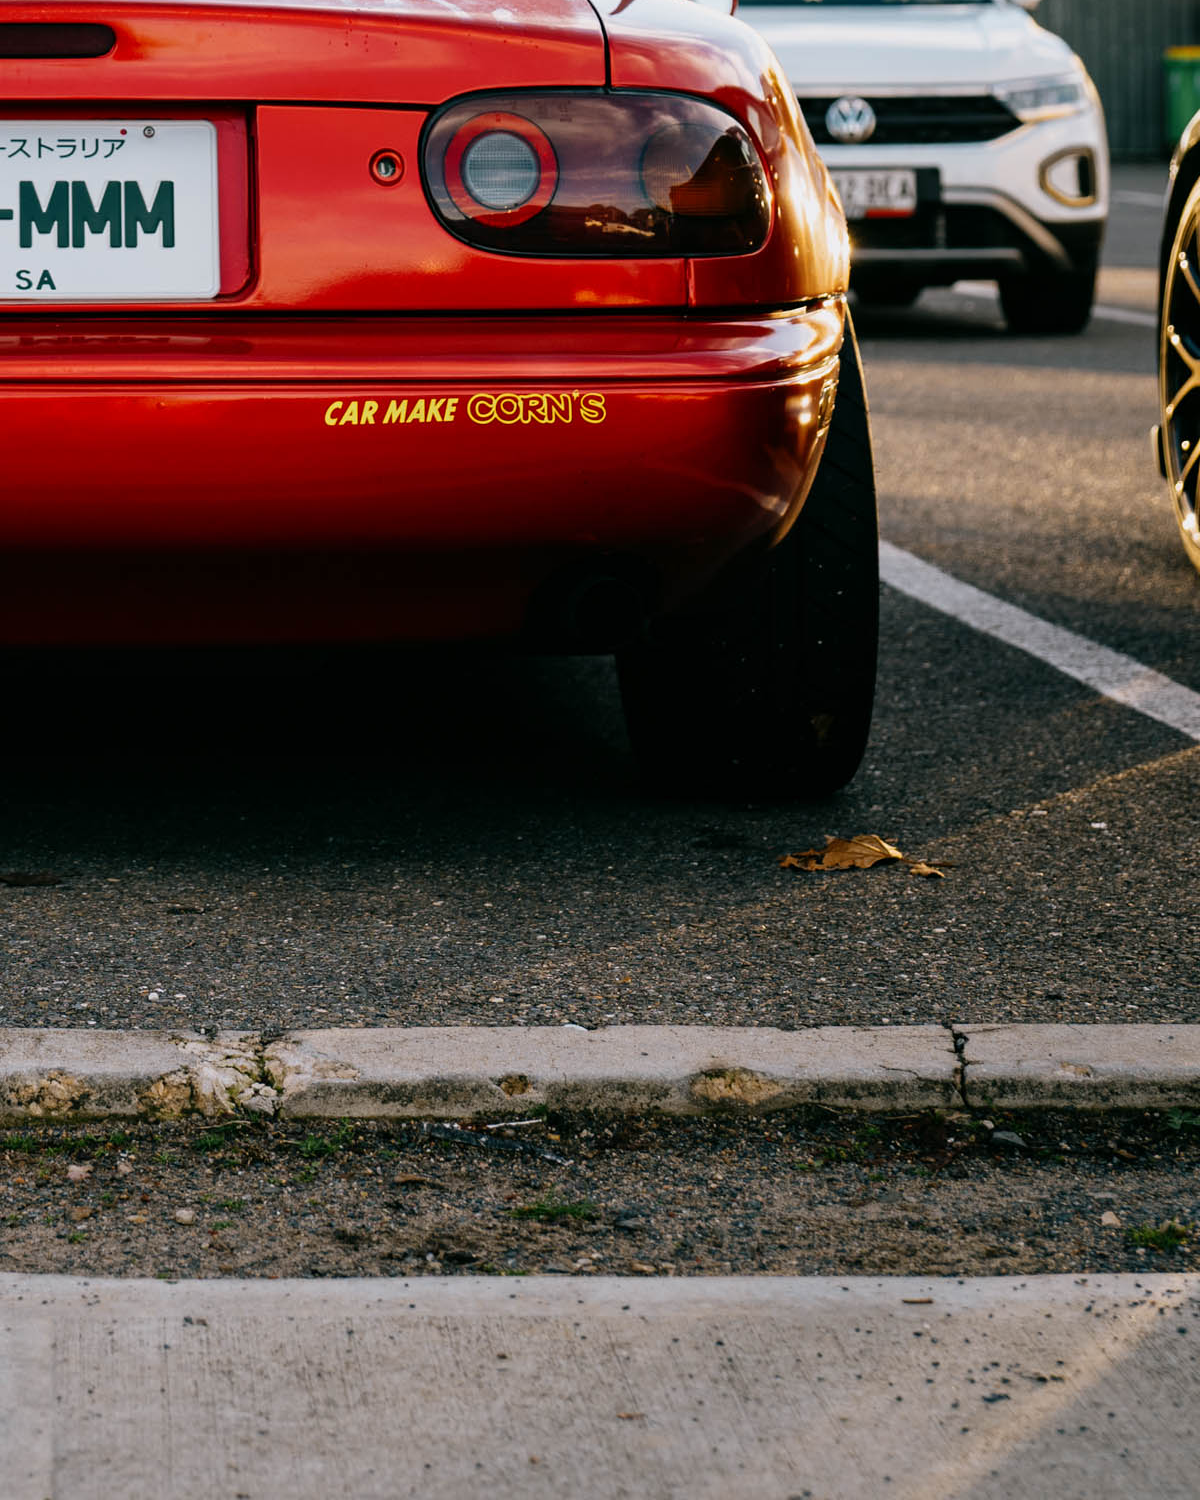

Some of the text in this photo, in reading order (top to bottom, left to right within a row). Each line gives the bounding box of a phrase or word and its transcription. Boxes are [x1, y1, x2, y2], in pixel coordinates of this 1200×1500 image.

[15, 269, 57, 291] SA
[324, 389, 607, 426] CAR MAKE CORN'S
